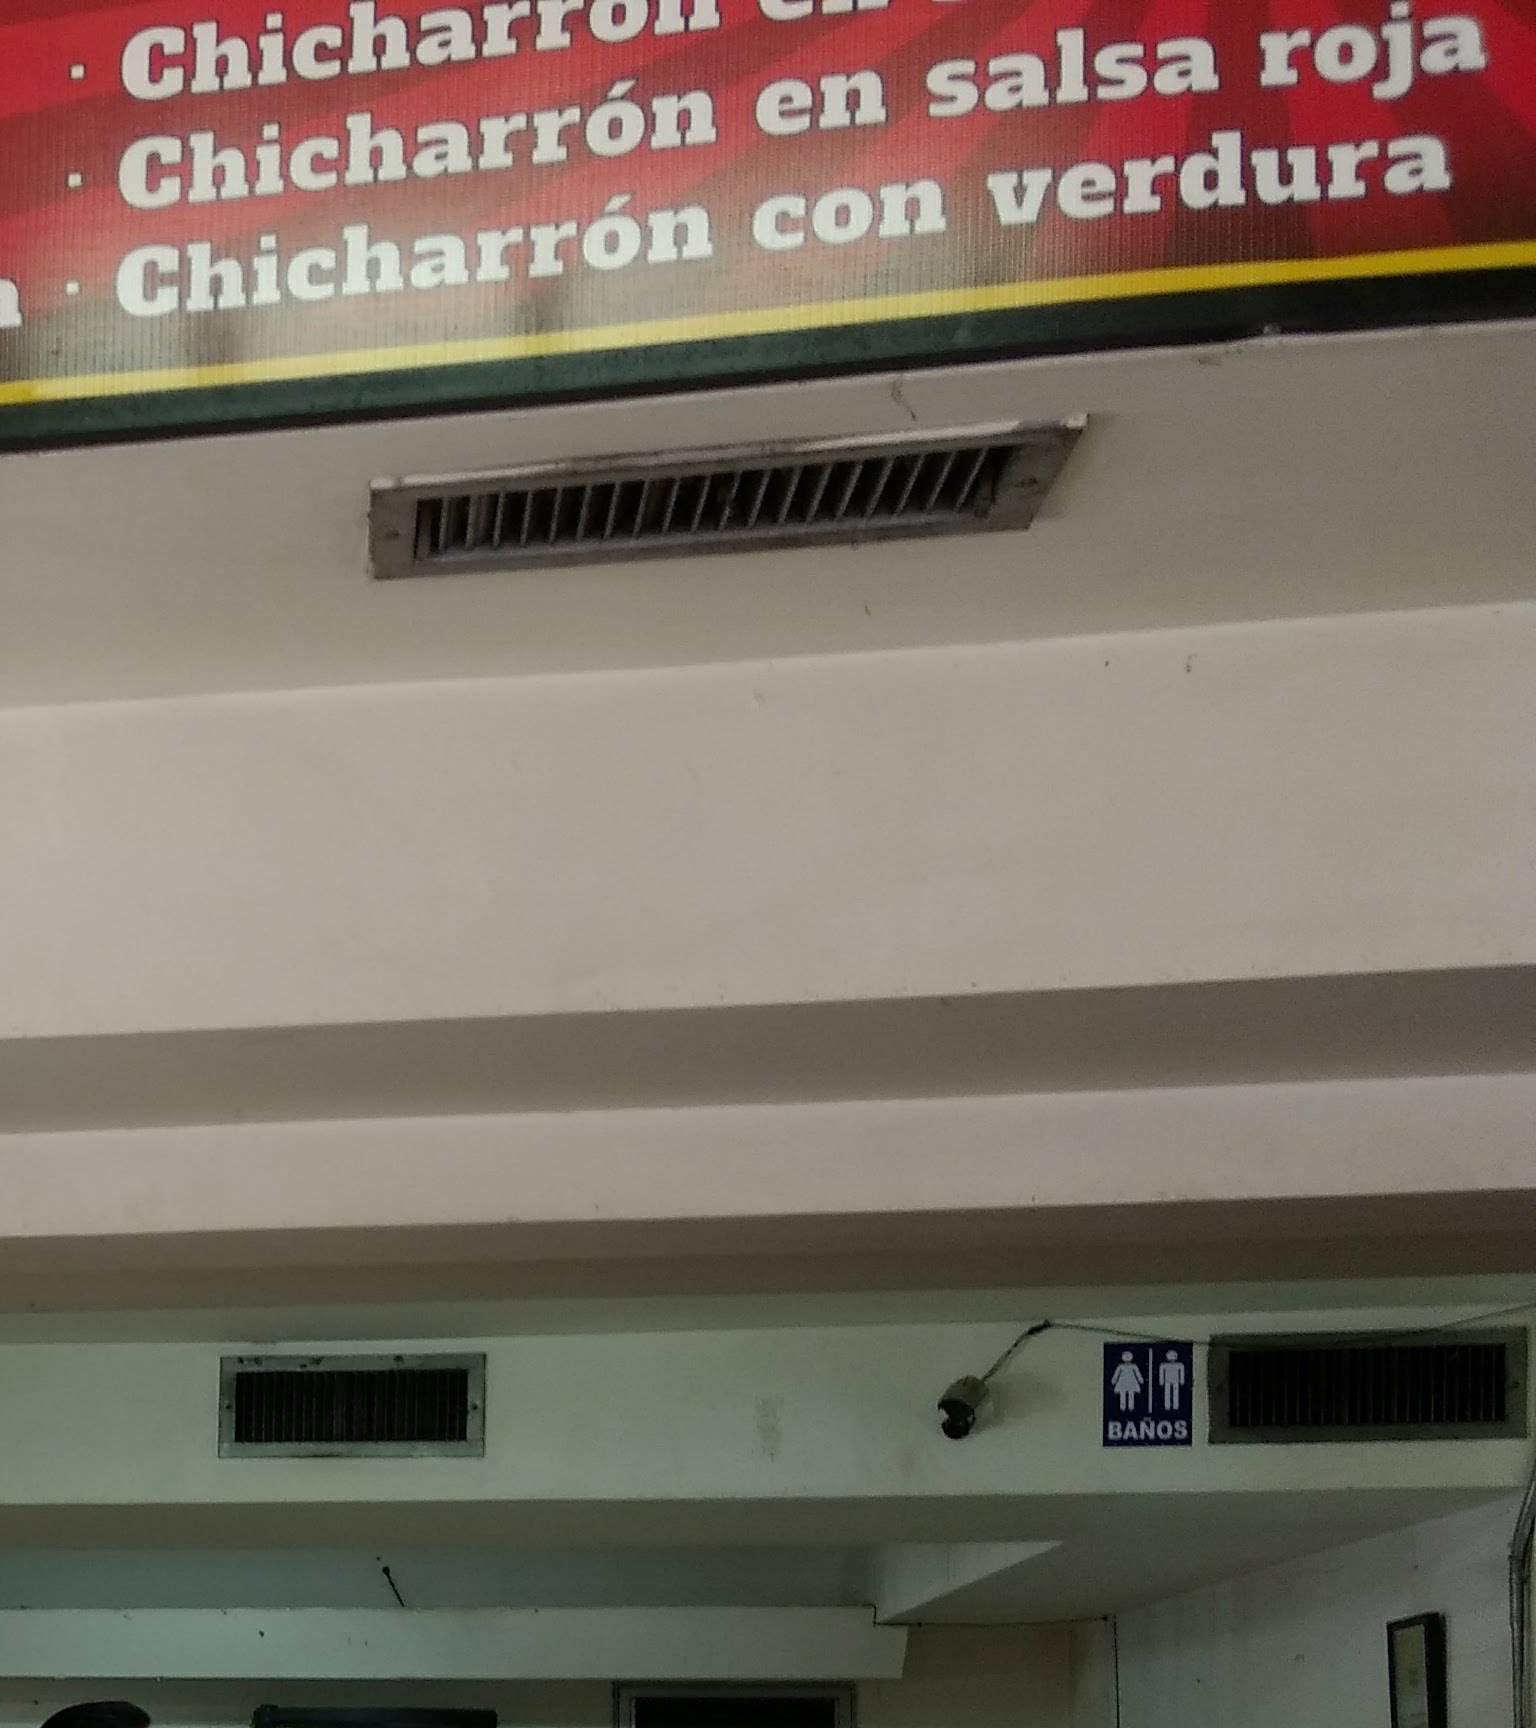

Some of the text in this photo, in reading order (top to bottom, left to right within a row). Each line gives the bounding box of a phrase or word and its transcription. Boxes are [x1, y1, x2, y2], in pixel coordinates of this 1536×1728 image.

[118, 0, 1488, 209] Chicharrón en salsa roja
[115, 129, 1454, 319] Chicharrón con verdura
[1107, 1417, 1189, 1442] BAÑOS
